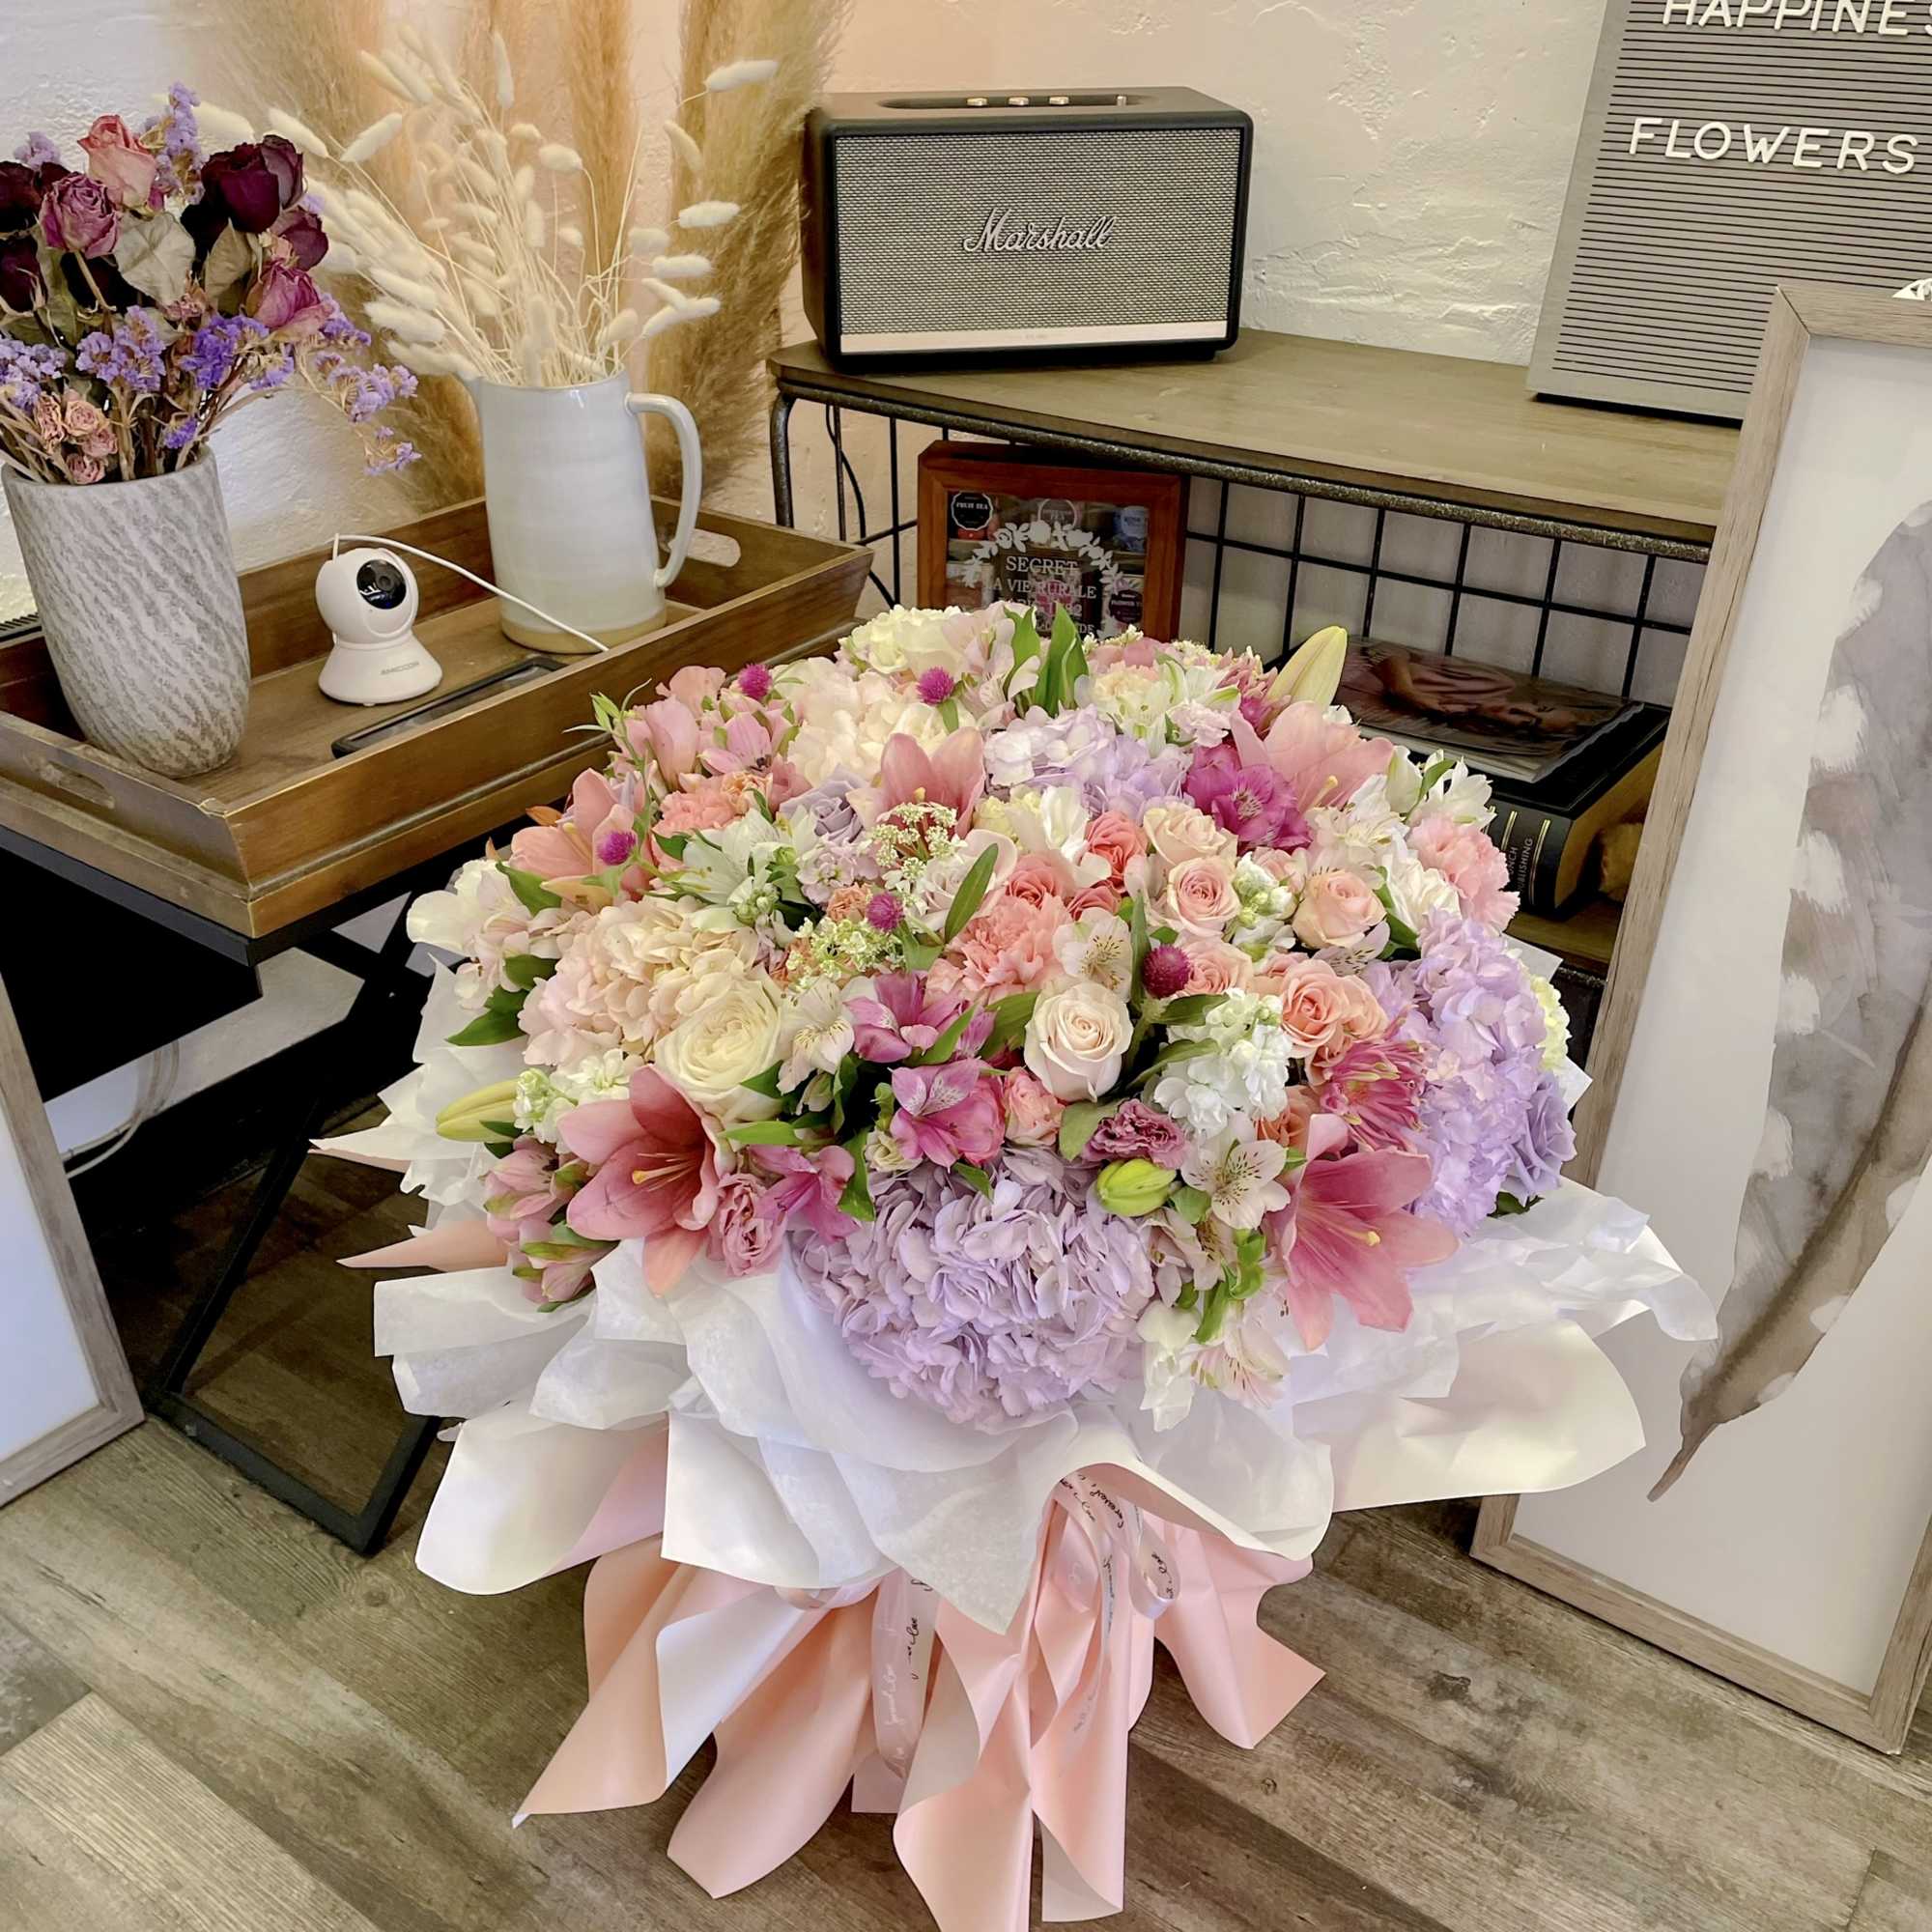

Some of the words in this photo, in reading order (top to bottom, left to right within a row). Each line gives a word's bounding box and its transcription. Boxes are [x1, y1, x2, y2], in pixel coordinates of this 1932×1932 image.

[1662, 0, 1932, 36] HAPPINE
[1629, 118, 1919, 175] FLOWERS
[962, 208, 1118, 253] Marshall
[1006, 555, 1079, 576] SECRET
[1007, 579, 1032, 593] VIE
[1036, 581, 1097, 599] RURALE
